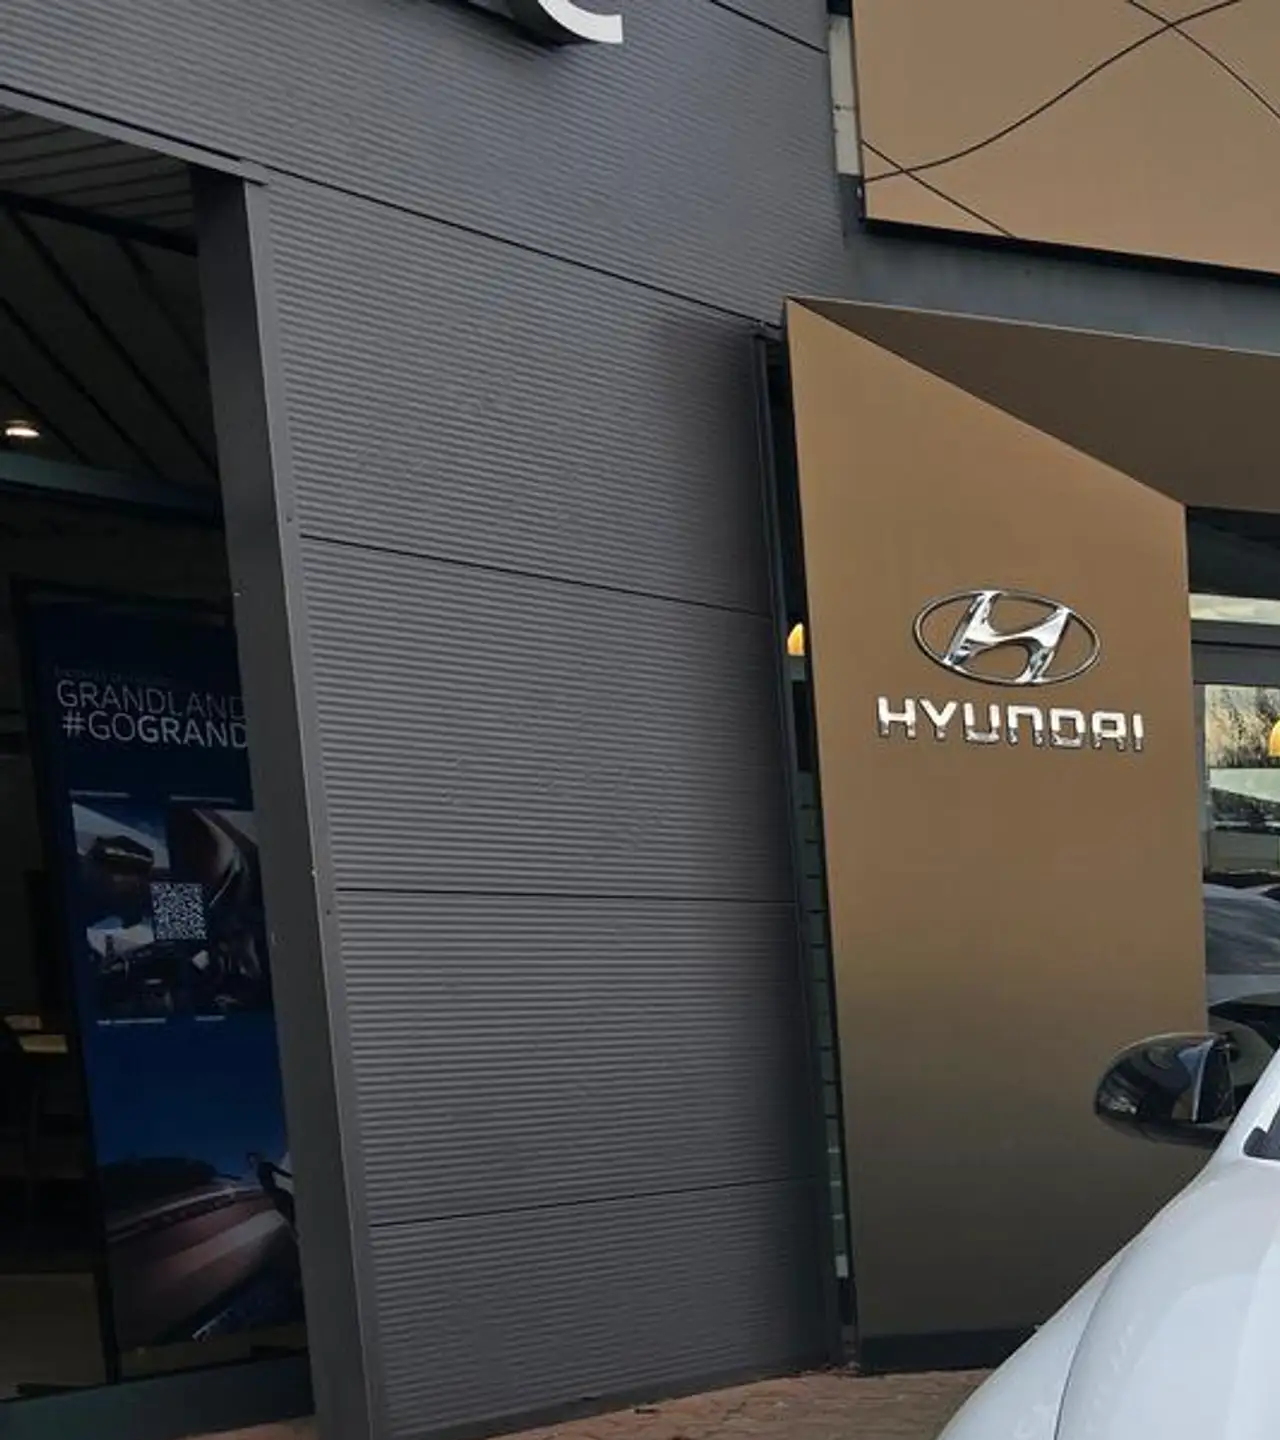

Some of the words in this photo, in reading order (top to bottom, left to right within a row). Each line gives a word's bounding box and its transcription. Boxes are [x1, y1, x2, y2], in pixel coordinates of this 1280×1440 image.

[56, 679, 249, 721] GRANDLAND
[62, 709, 248, 749] #GOGRAND
[877, 696, 1144, 751] HYUNDAI
